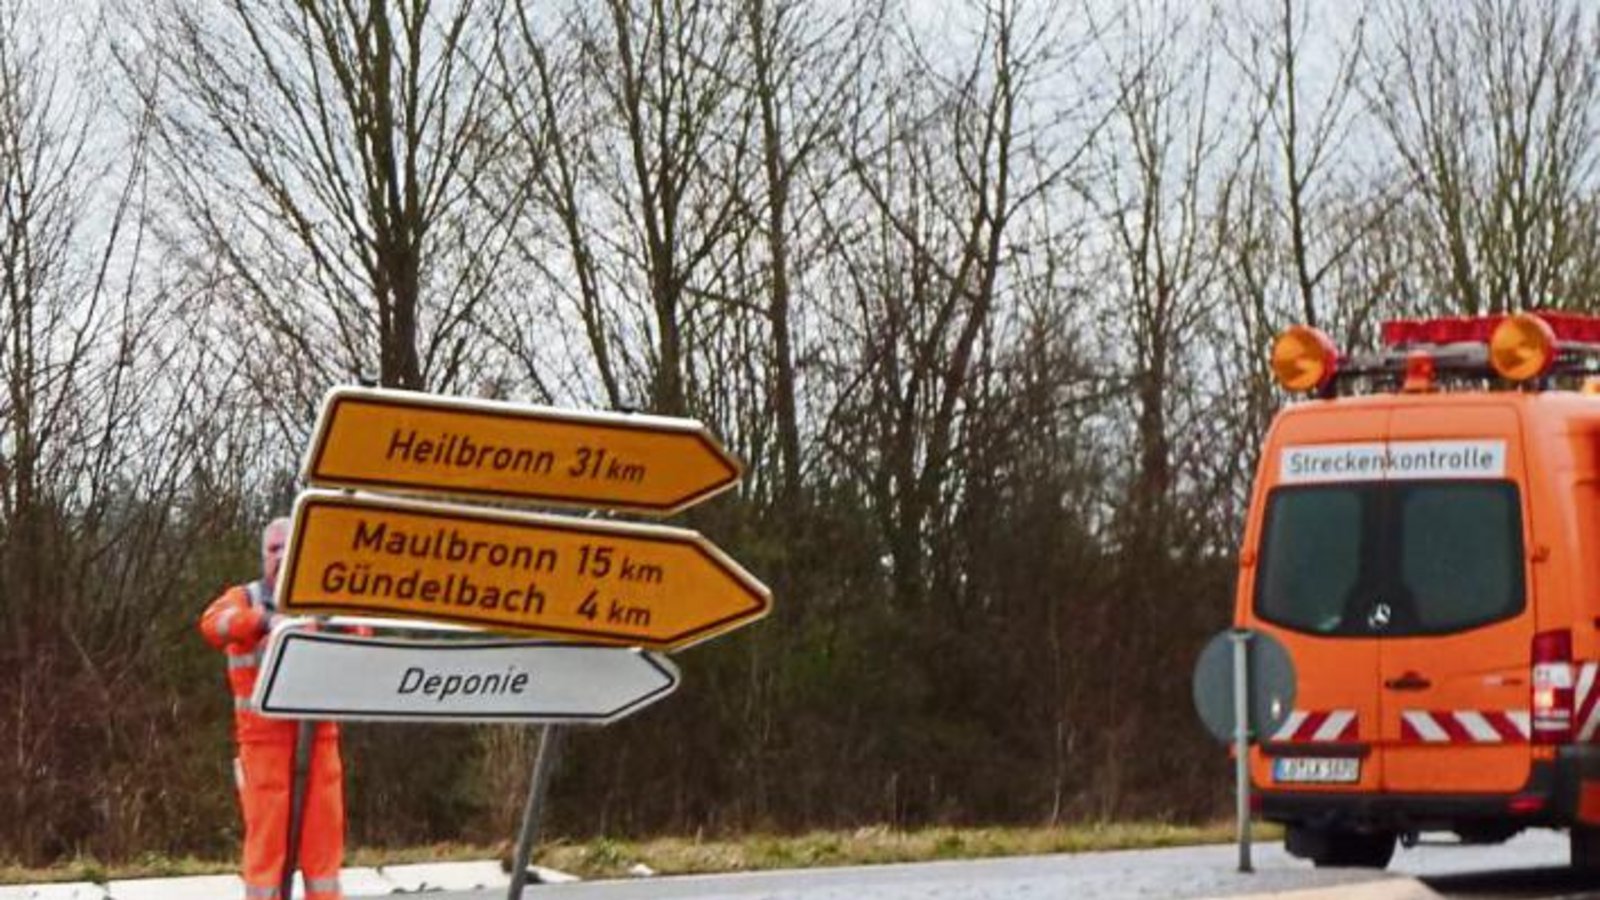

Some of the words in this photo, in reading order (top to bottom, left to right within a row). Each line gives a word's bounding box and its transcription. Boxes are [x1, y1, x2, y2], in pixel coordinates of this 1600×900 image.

[386, 430, 554, 475] Heilbronn
[568, 448, 606, 479] 31
[608, 455, 646, 484] km
[1291, 447, 1492, 474] Streckenkontrolle
[352, 520, 557, 573] Maulbronn
[577, 545, 614, 576] 15
[621, 556, 664, 584] km
[322, 562, 545, 615] Gündelbach
[577, 590, 599, 621] 4
[608, 598, 652, 627] km
[397, 665, 529, 701] Deponie
